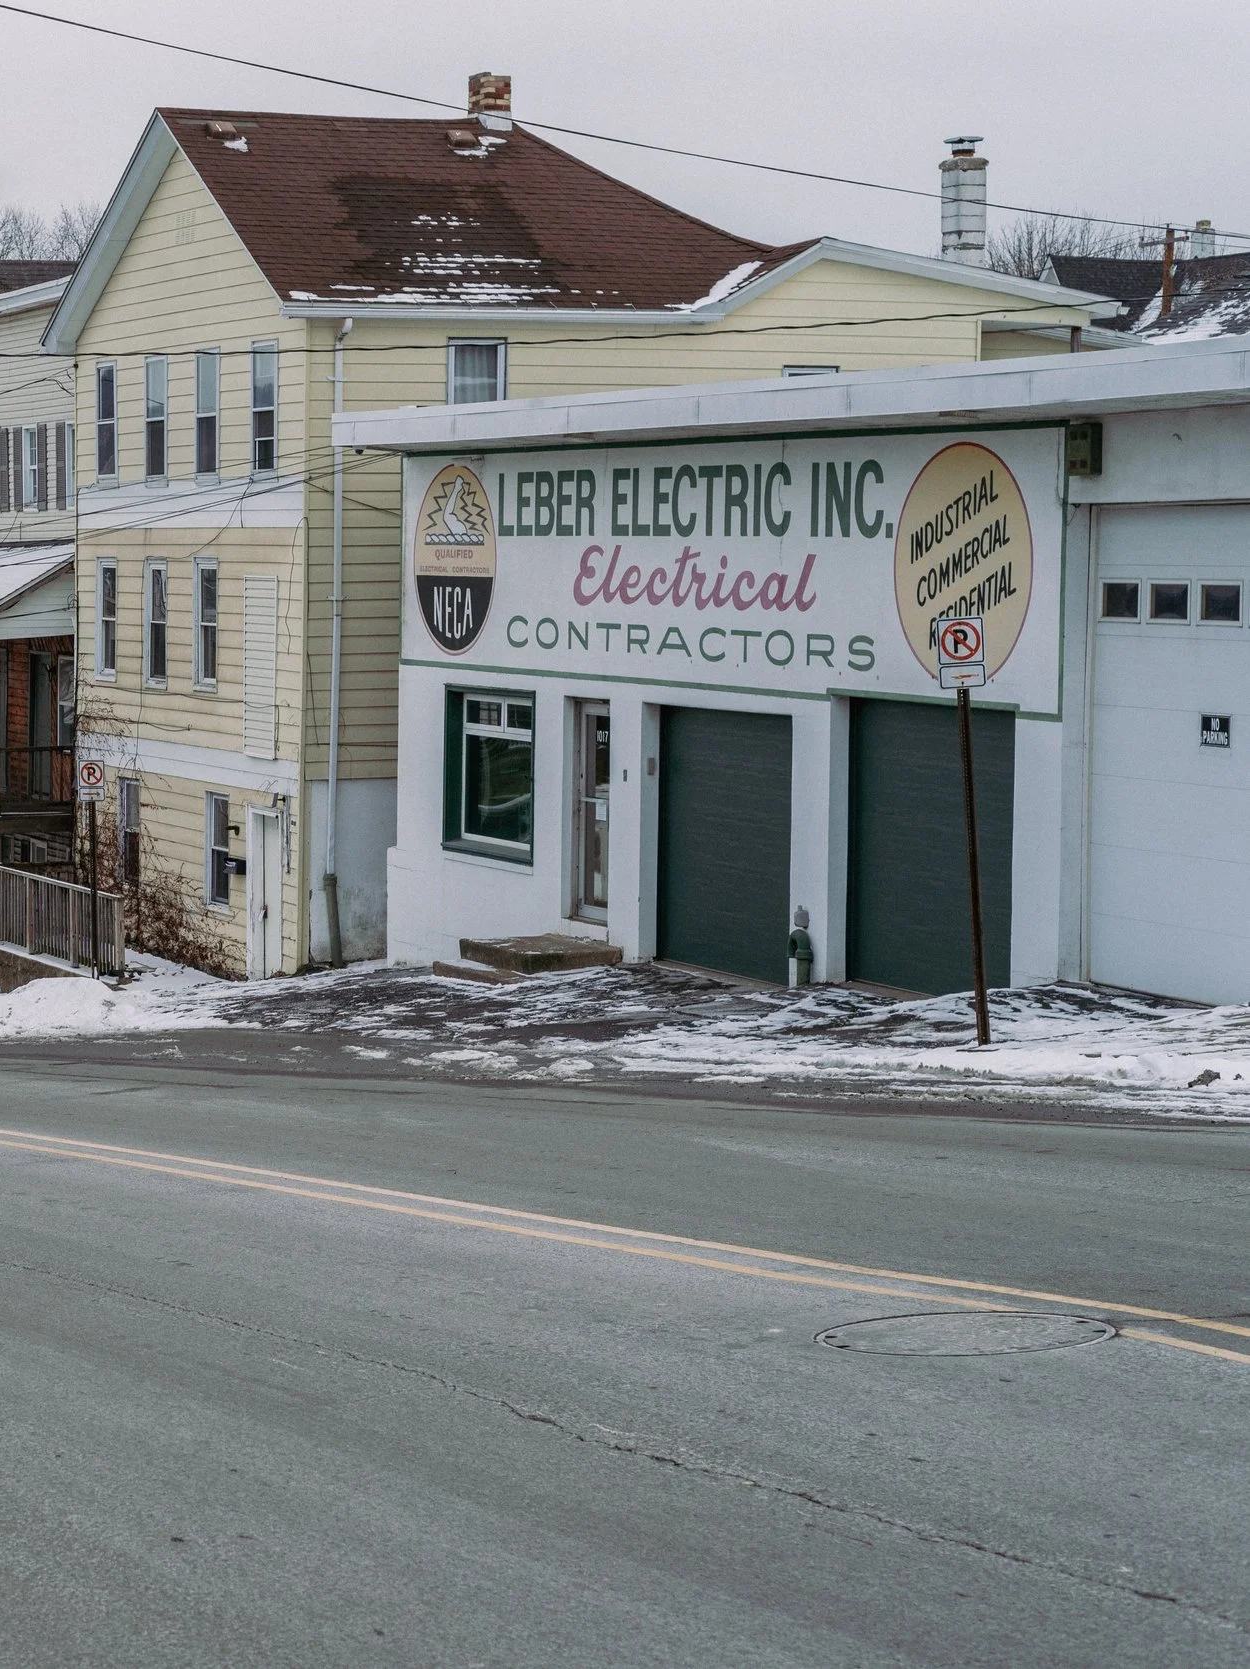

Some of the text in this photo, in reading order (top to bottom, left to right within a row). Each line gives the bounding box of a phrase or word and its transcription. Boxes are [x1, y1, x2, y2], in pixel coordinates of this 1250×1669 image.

[498, 459, 894, 539] LEBER ELECTRIC INC.
[910, 469, 999, 565] INDUSTRIAL
[419, 565, 490, 574] ELECTRICAL CONTRACTORS
[434, 548, 474, 560] QUALIFIED
[573, 544, 817, 612] Electrical
[916, 513, 1011, 608] COMMERCIAL
[433, 586, 473, 639] NECA
[506, 615, 876, 672] CONTRACTORS
[596, 730, 608, 742] 1017
[1202, 730, 1228, 744] PARKING
[1211, 718, 1220, 730] NO
